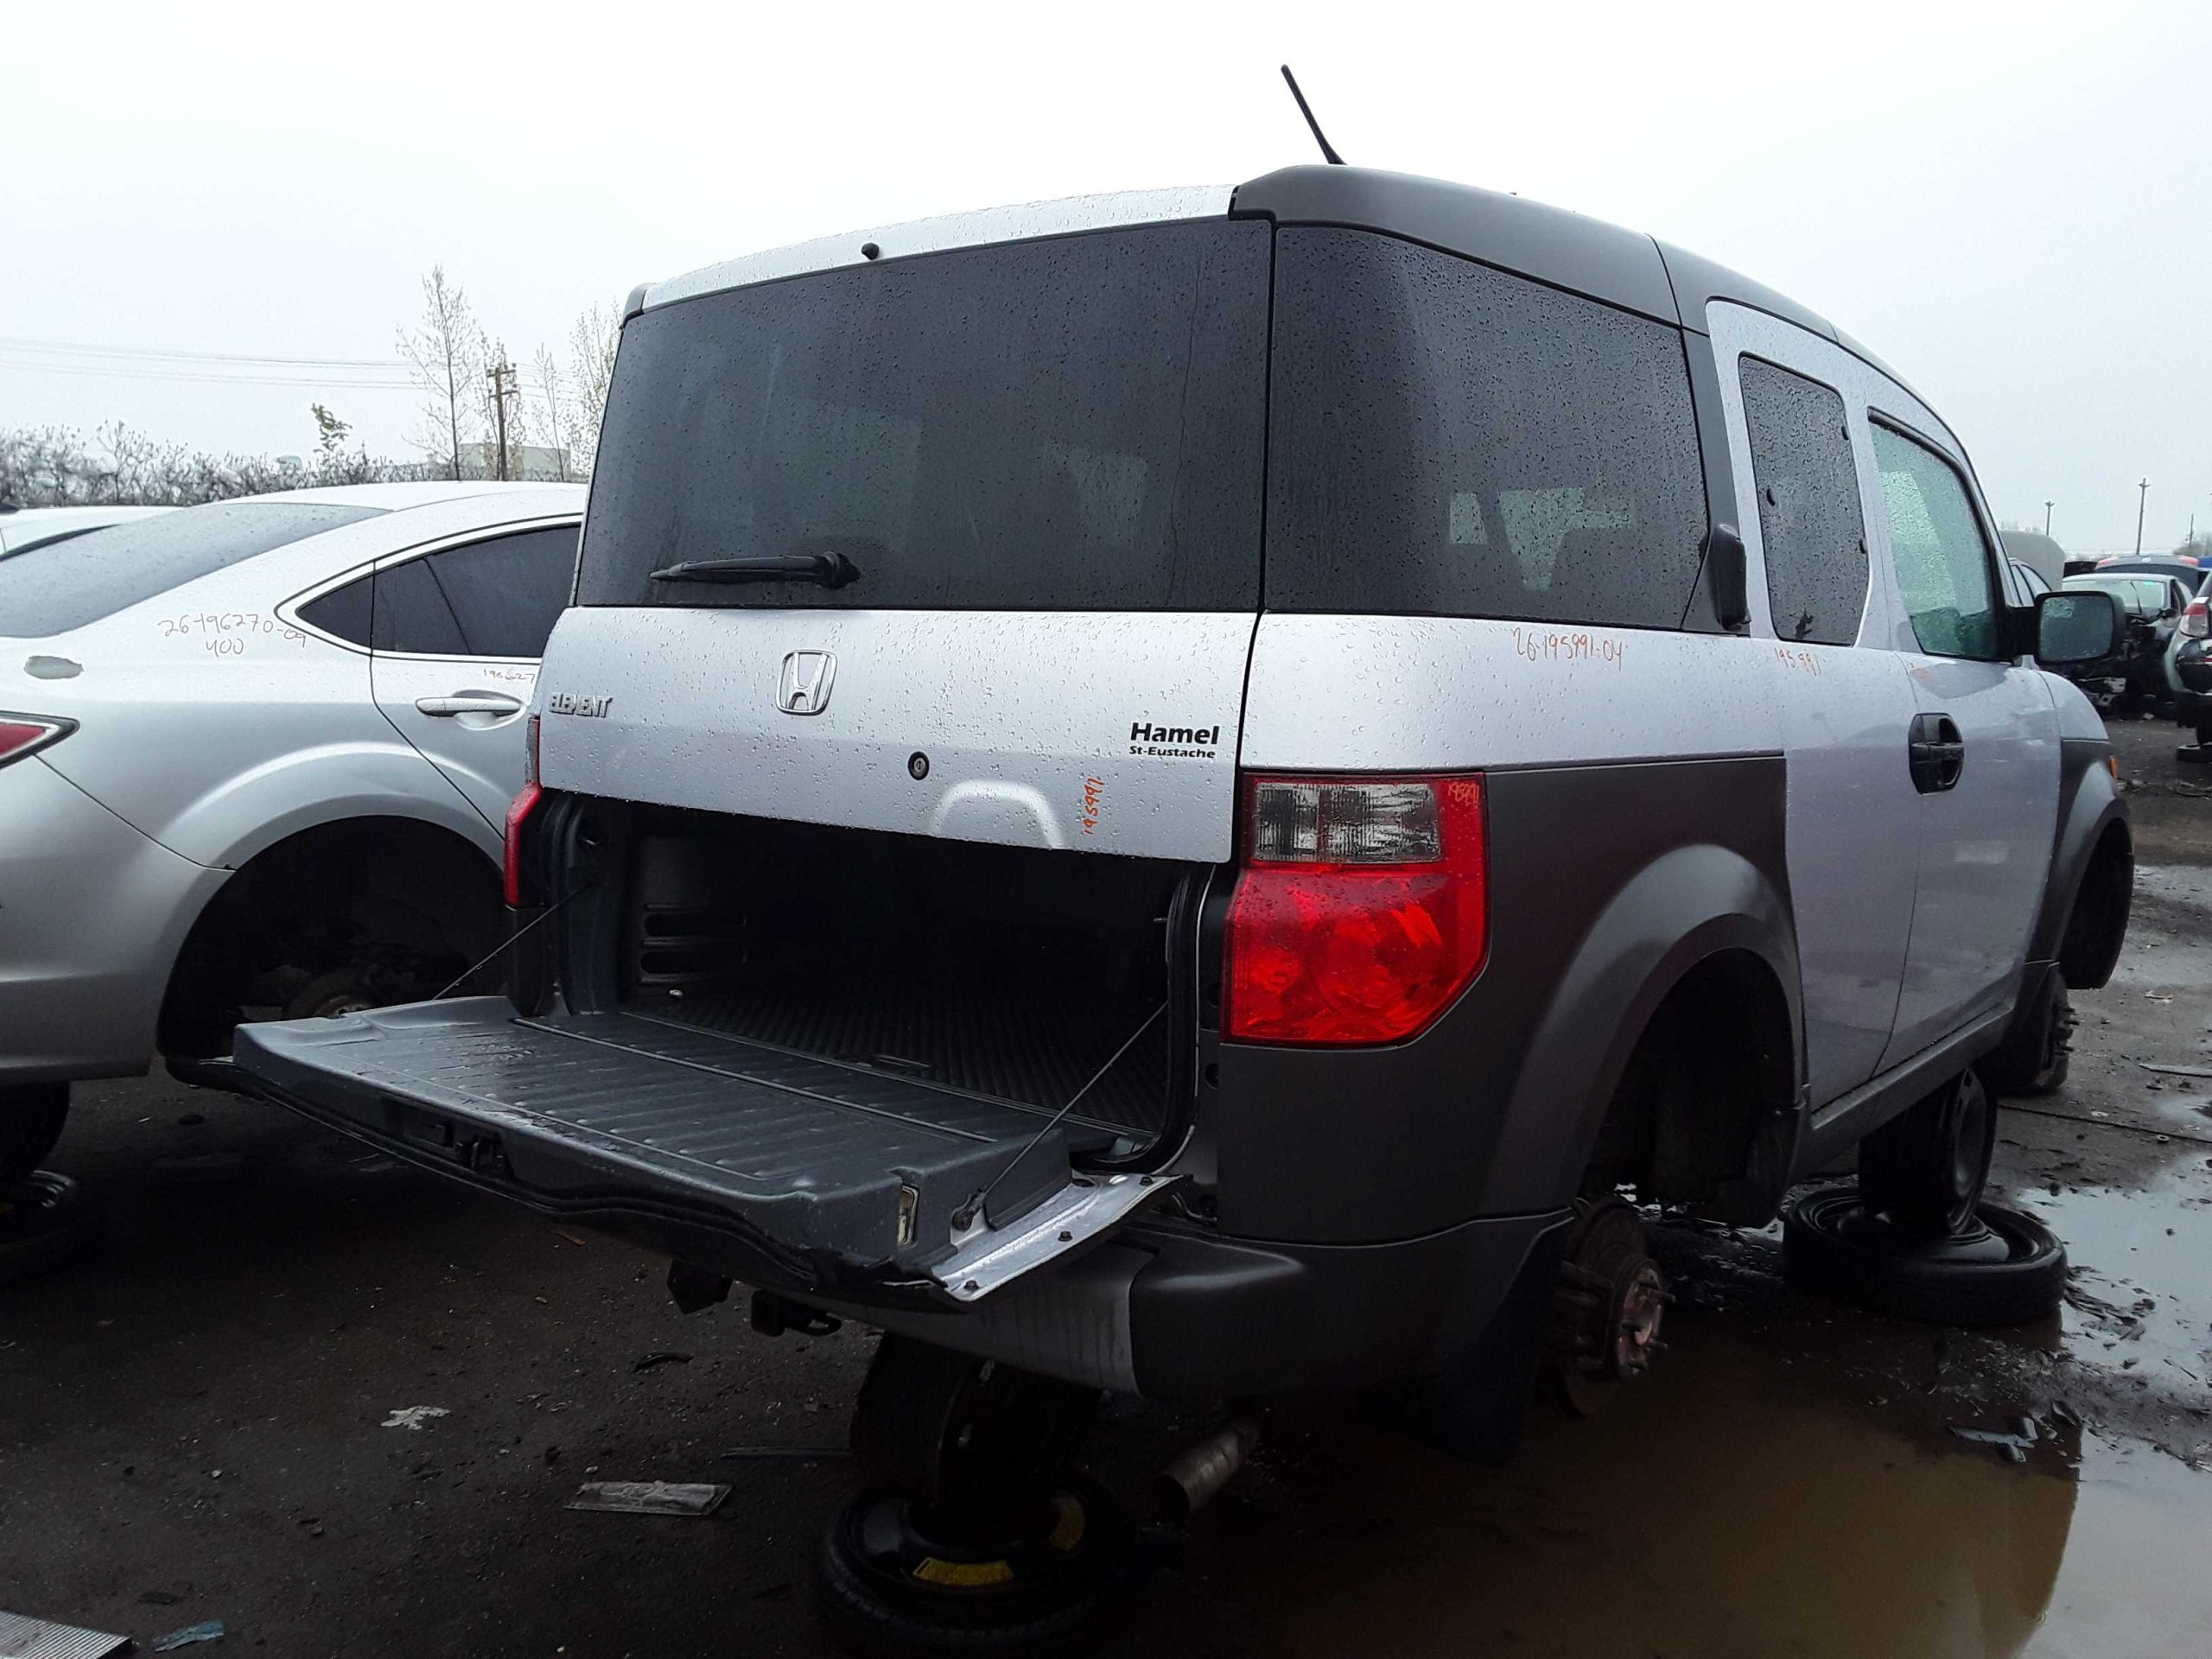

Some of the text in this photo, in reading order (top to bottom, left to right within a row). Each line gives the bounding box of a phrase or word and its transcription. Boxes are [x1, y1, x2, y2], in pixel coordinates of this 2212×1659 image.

[206, 638, 244, 658] 400
[1130, 722, 1220, 745] Hamel
[1128, 746, 1217, 759] St-Eustache
